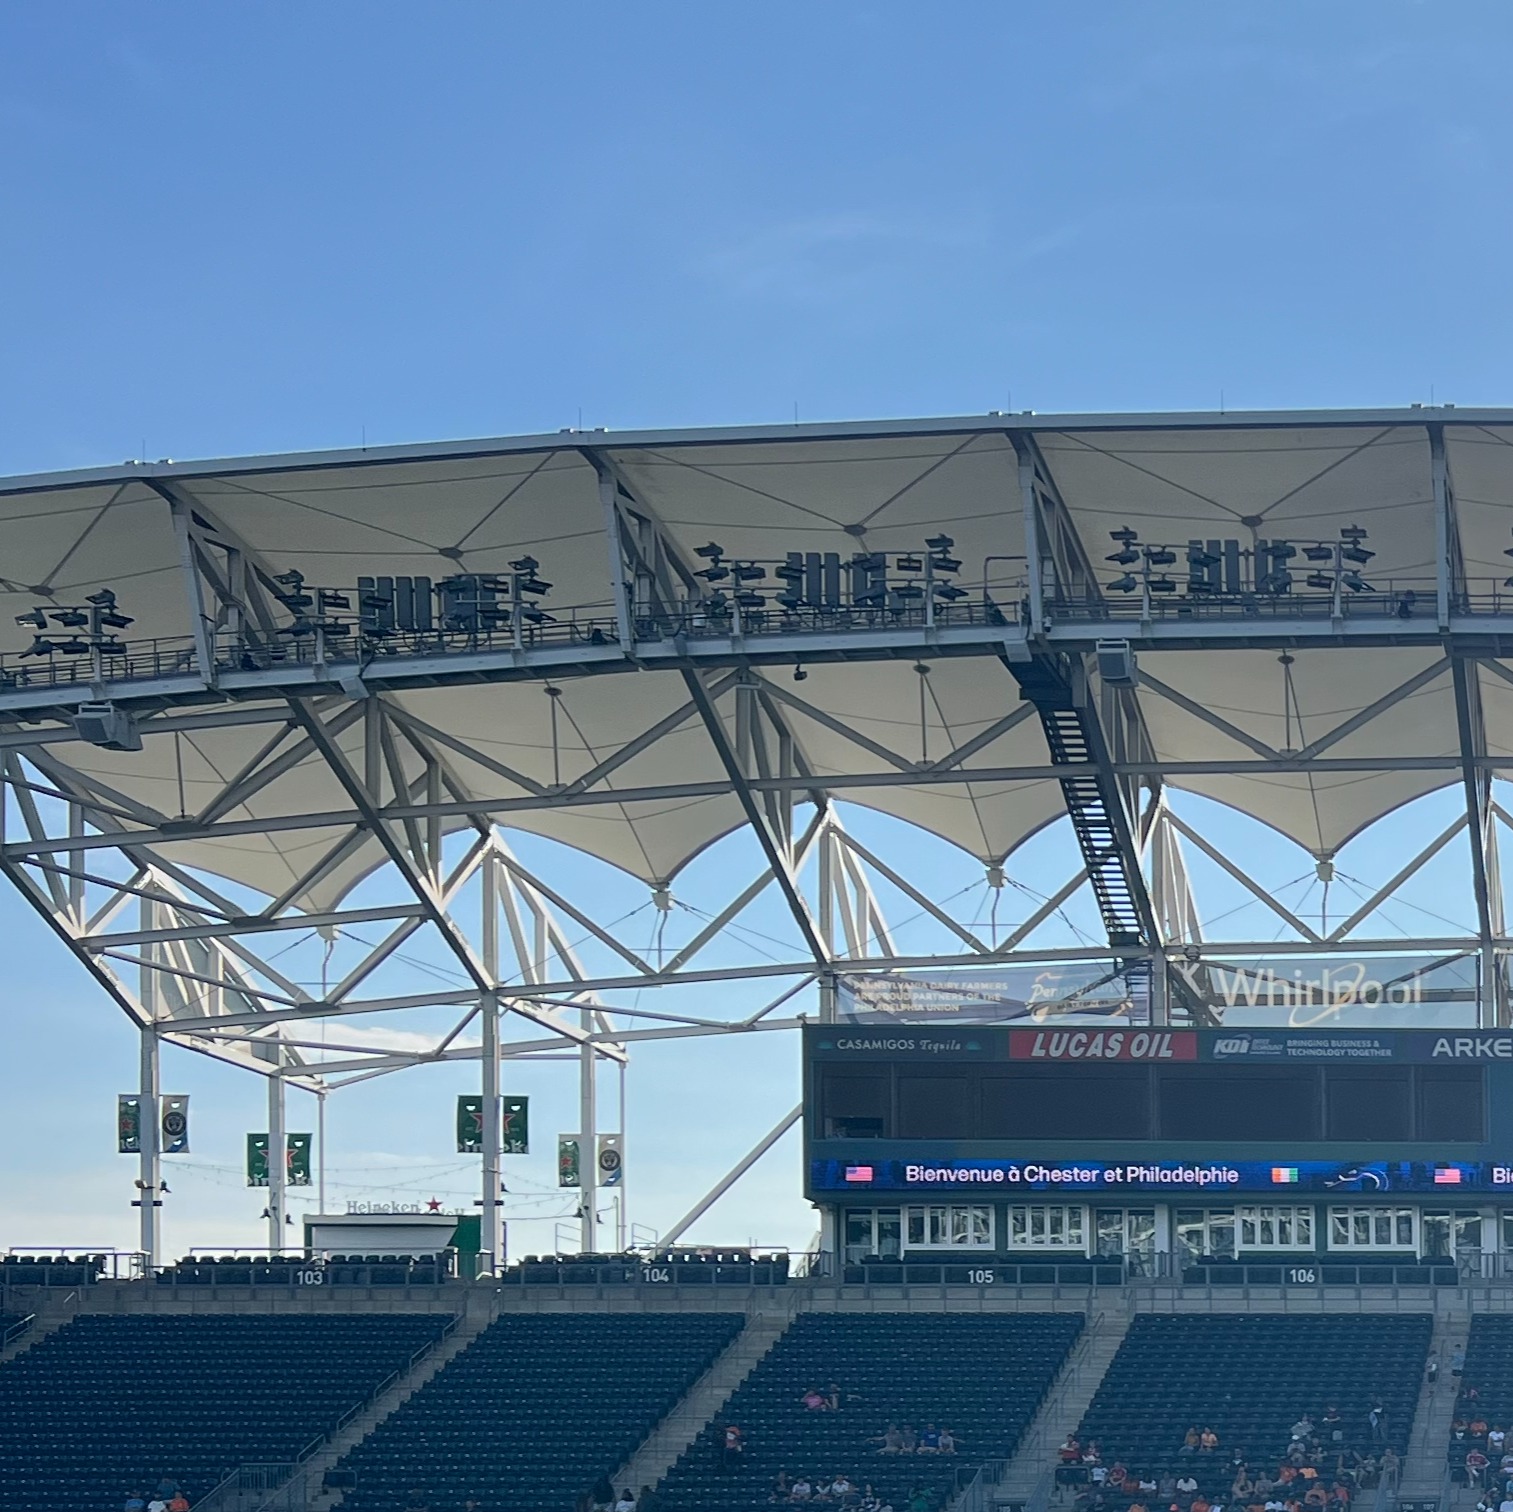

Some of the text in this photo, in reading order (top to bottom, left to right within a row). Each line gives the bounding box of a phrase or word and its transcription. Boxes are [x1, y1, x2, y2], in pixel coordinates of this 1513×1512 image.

[962, 982, 1008, 990] FARMERS
[913, 992, 964, 1001] PARTNERS
[966, 992, 979, 1001] OF
[982, 992, 1001, 1001] THE
[1217, 968, 1421, 1020] Whirlpool
[927, 1003, 960, 1012] UNION
[837, 1039, 961, 1053] CASAMIGOS Tequila
[1031, 1032, 1174, 1058] LUCAS OIL
[1286, 1039, 1330, 1048] BRINGING
[1331, 1039, 1372, 1048] BUSINESS
[1286, 1049, 1392, 1057] TECHNOLOGY TOGETHER
[906, 1165, 1239, 1186] Bienvenue à Chester et Philadelphie
[346, 1200, 421, 1214] Heineken
[297, 1270, 323, 1285] 103
[643, 1268, 669, 1282] 104
[968, 1270, 994, 1284] 105
[1290, 1269, 1315, 1283] 106
